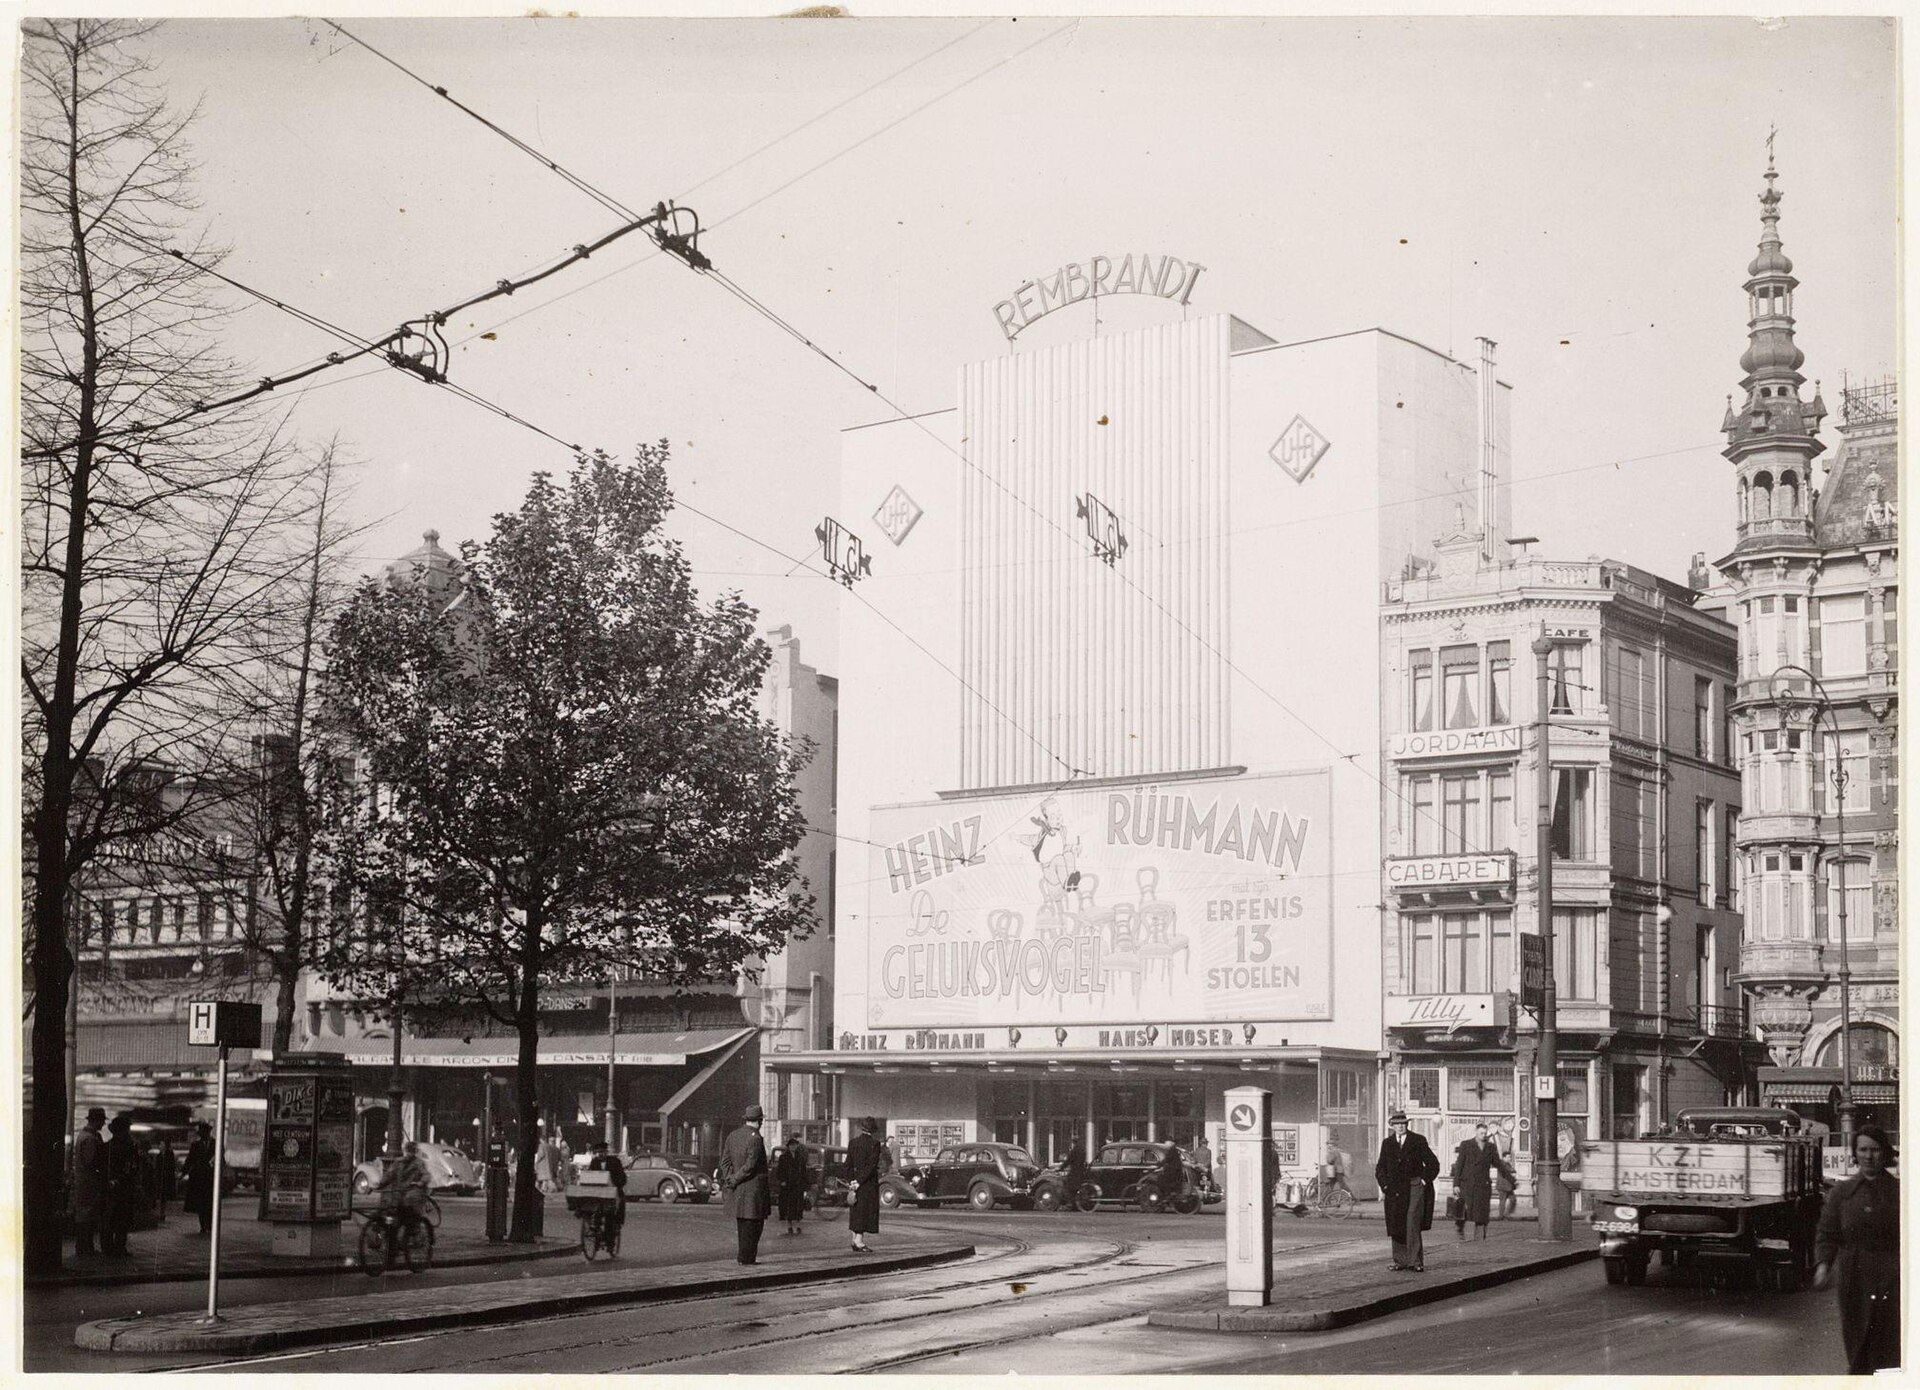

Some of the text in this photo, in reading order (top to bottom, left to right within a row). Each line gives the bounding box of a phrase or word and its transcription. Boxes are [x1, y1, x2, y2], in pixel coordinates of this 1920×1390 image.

[992, 252, 1208, 340] REMBRANDT
[1394, 728, 1517, 755] JORDAAN
[884, 785, 1309, 895] HEINZ RÜHMANN
[1388, 860, 1506, 883] CABARET
[905, 889, 950, 938] De
[1206, 896, 1303, 922] ERFENIS
[1234, 924, 1272, 963] 13
[881, 935, 1106, 1000] GELUKSVOGEL
[1207, 965, 1300, 989] STOELEN
[195, 1004, 211, 1029] H
[1403, 996, 1469, 1034] Tilly
[1098, 1029, 1233, 1047] HANS MOSER
[1540, 1077, 1550, 1090] H
[1621, 1171, 1745, 1190] AMSTERDAM
